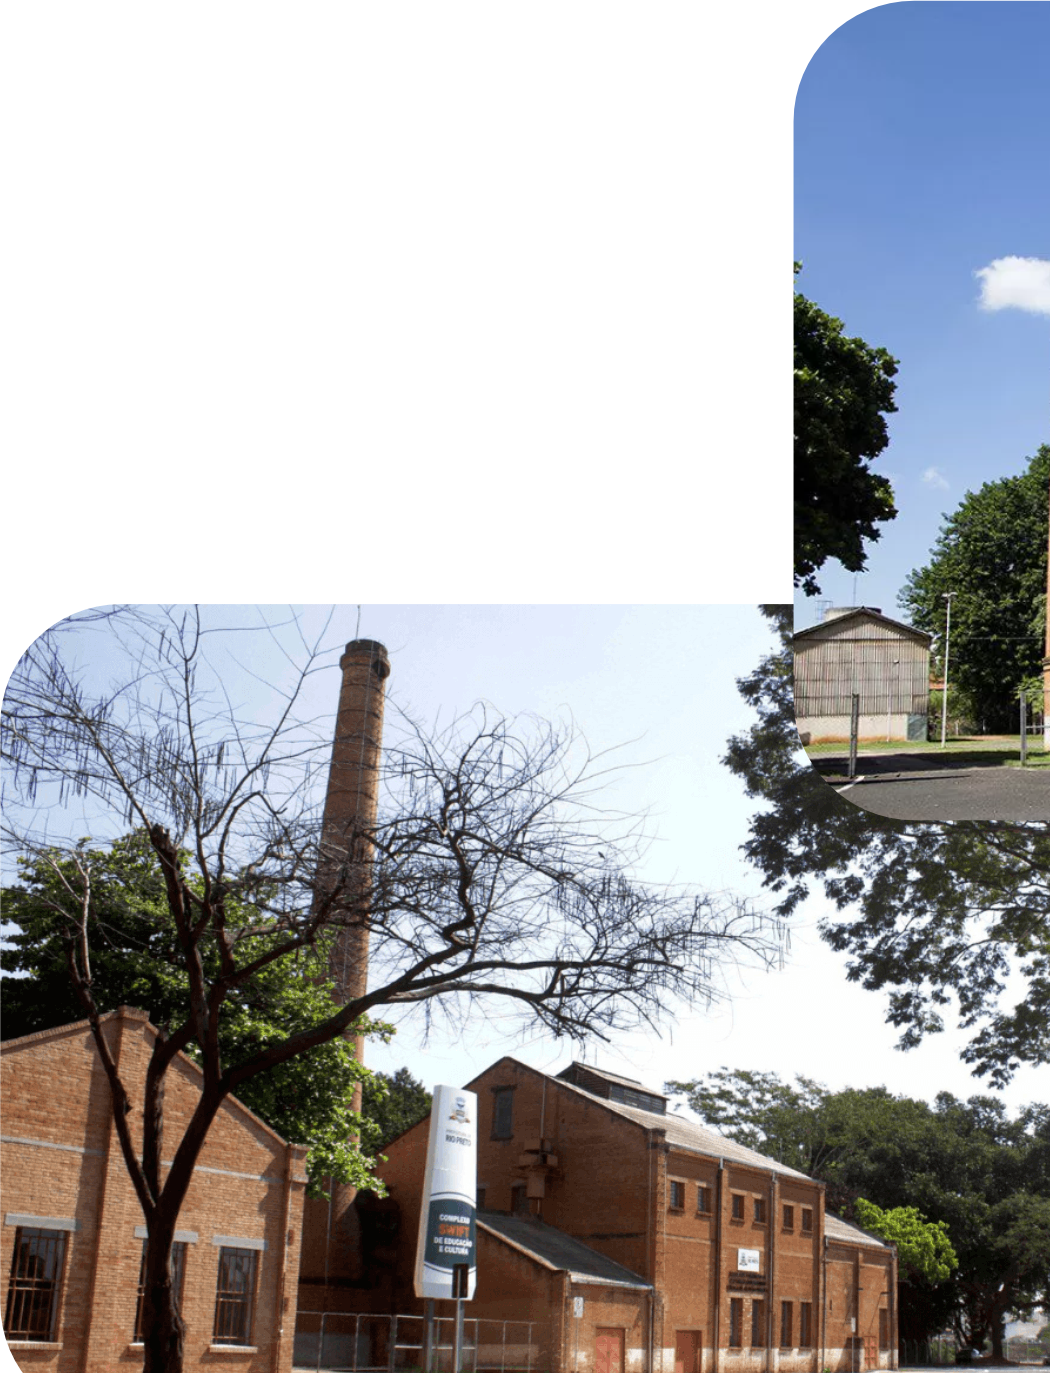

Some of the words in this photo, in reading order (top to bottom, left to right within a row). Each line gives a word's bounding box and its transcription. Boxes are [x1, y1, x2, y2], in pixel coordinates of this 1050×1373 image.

[439, 1214, 470, 1224] COMPLEXO
[439, 1224, 469, 1237] SWIFT
[445, 1246, 469, 1255] CULTURA
